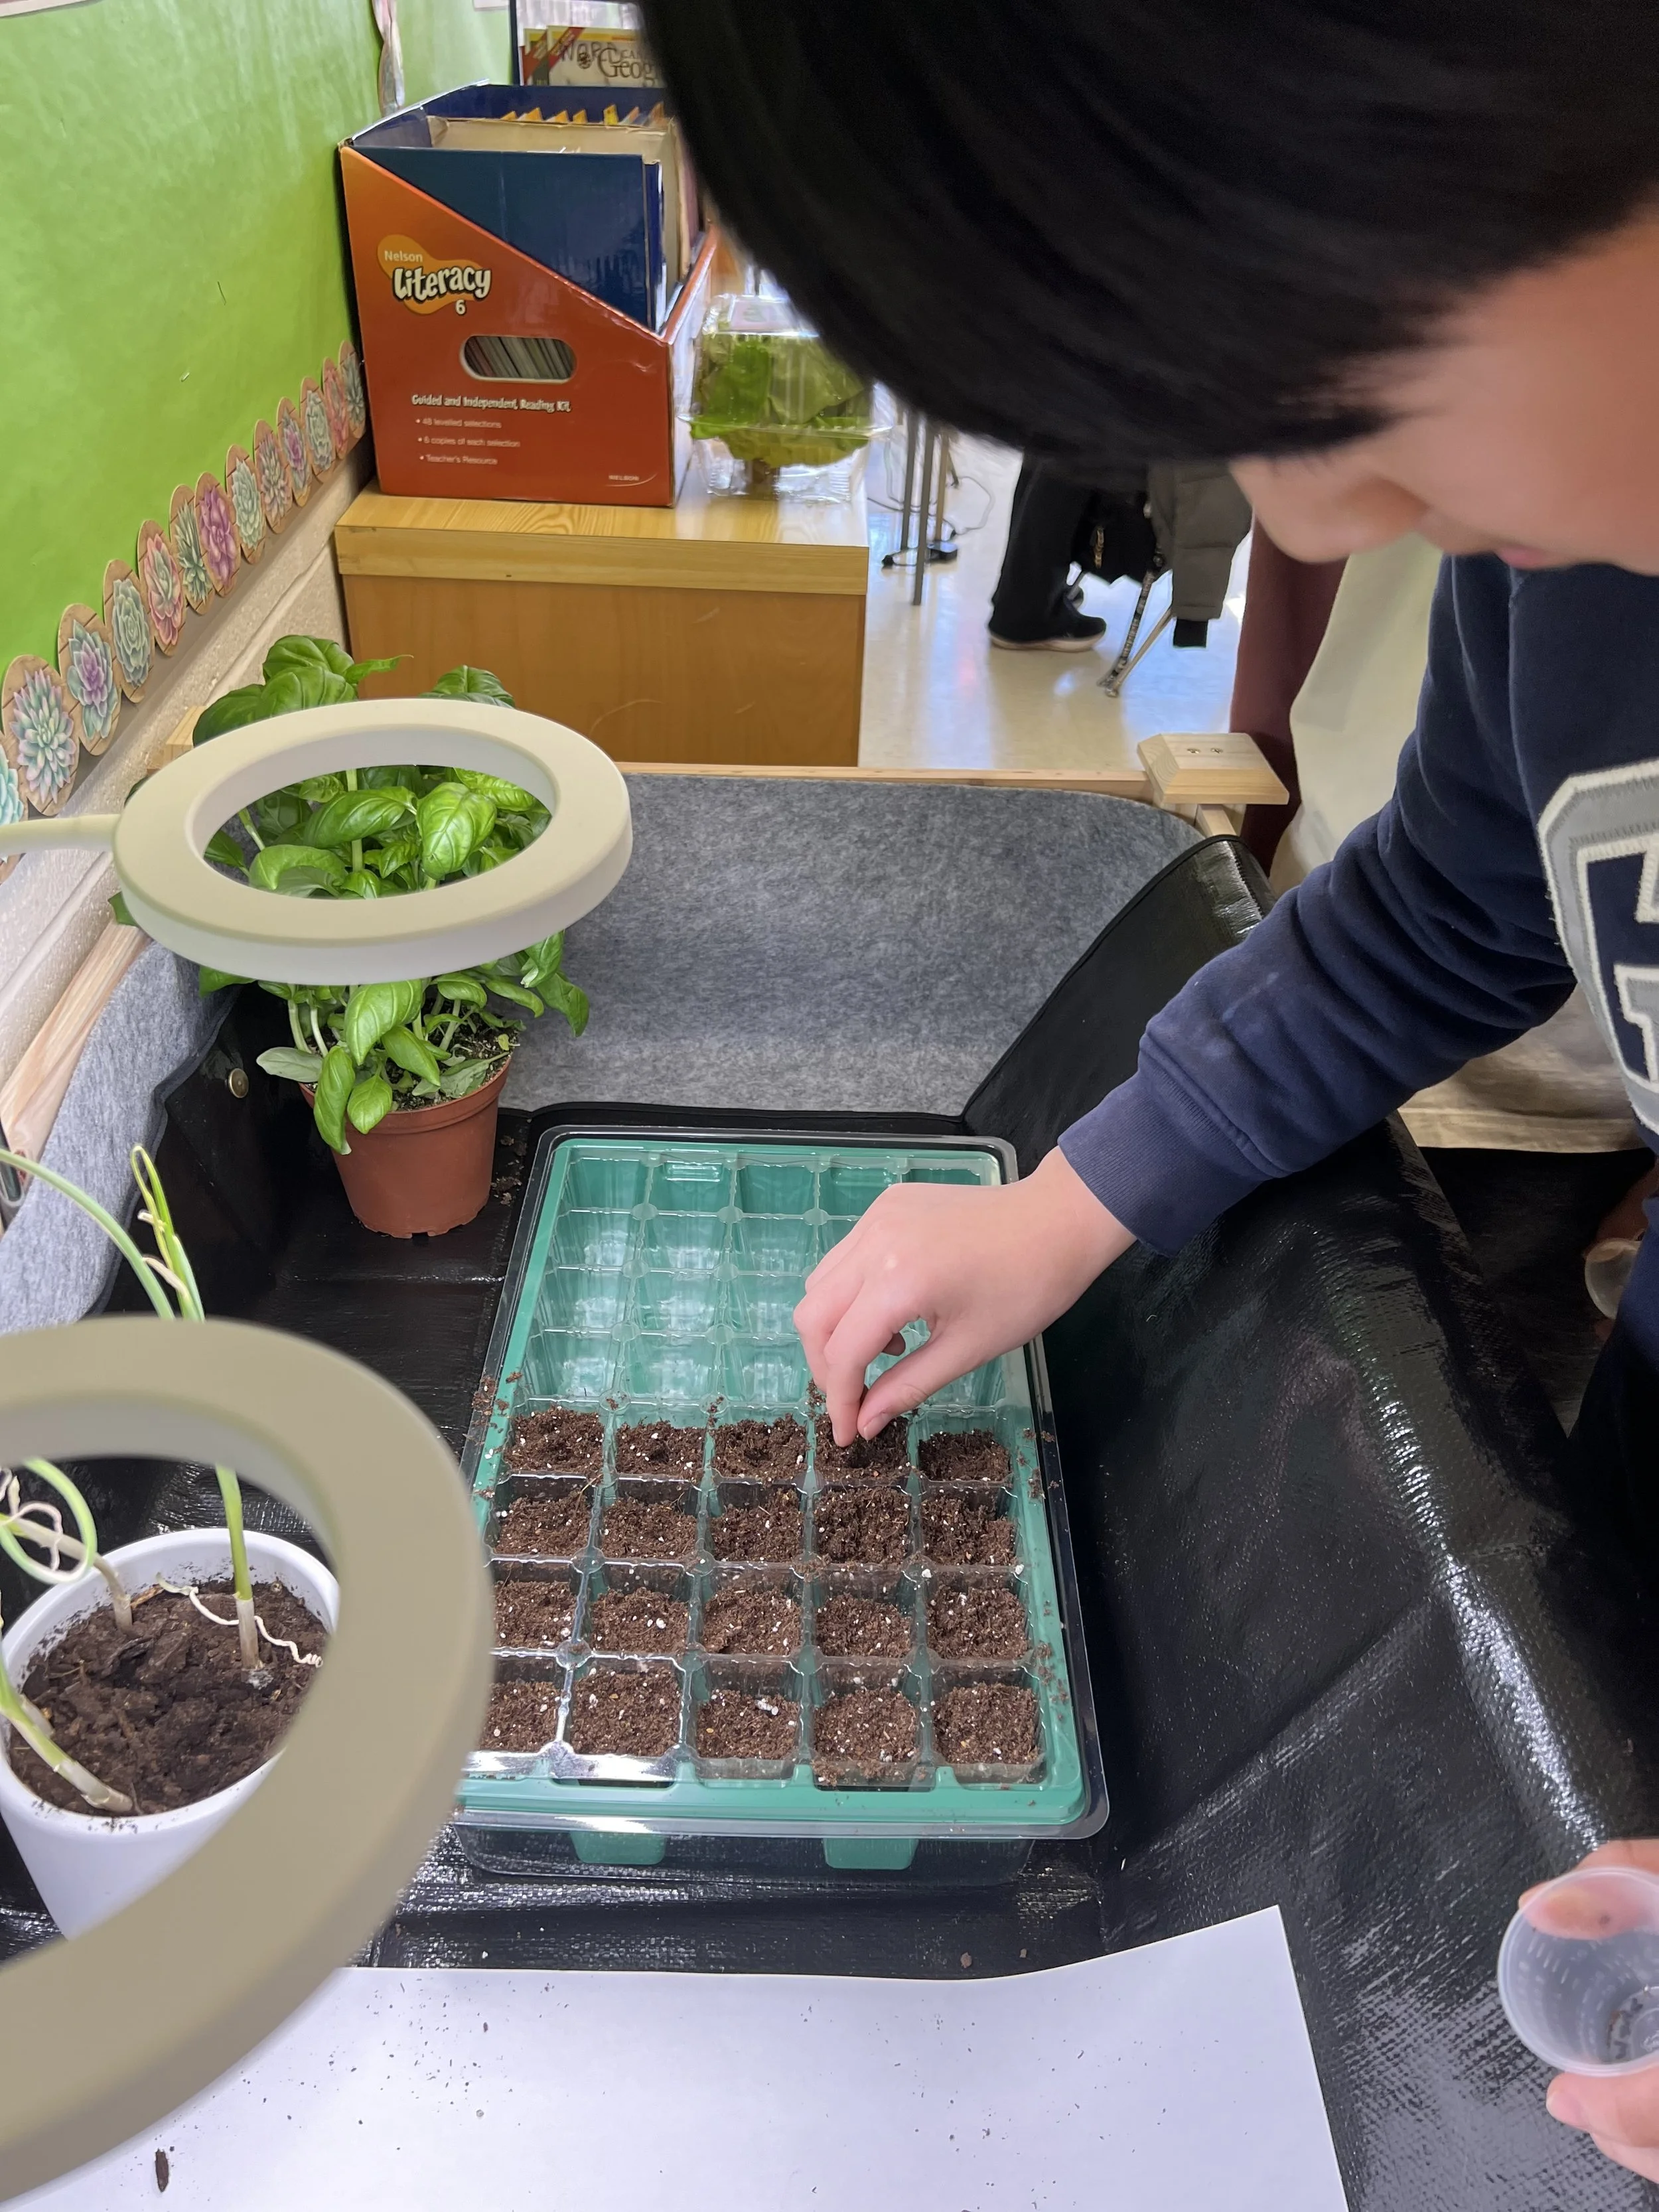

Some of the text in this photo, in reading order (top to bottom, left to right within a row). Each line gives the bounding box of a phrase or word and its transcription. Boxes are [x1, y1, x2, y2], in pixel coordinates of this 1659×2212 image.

[384, 250, 423, 263] Nelson
[394, 266, 492, 302] Literacy
[455, 299, 466, 315] 6
[412, 394, 571, 413] Guided and Independent Reading Kit
[425, 454, 498, 465] Teacher's Resource
